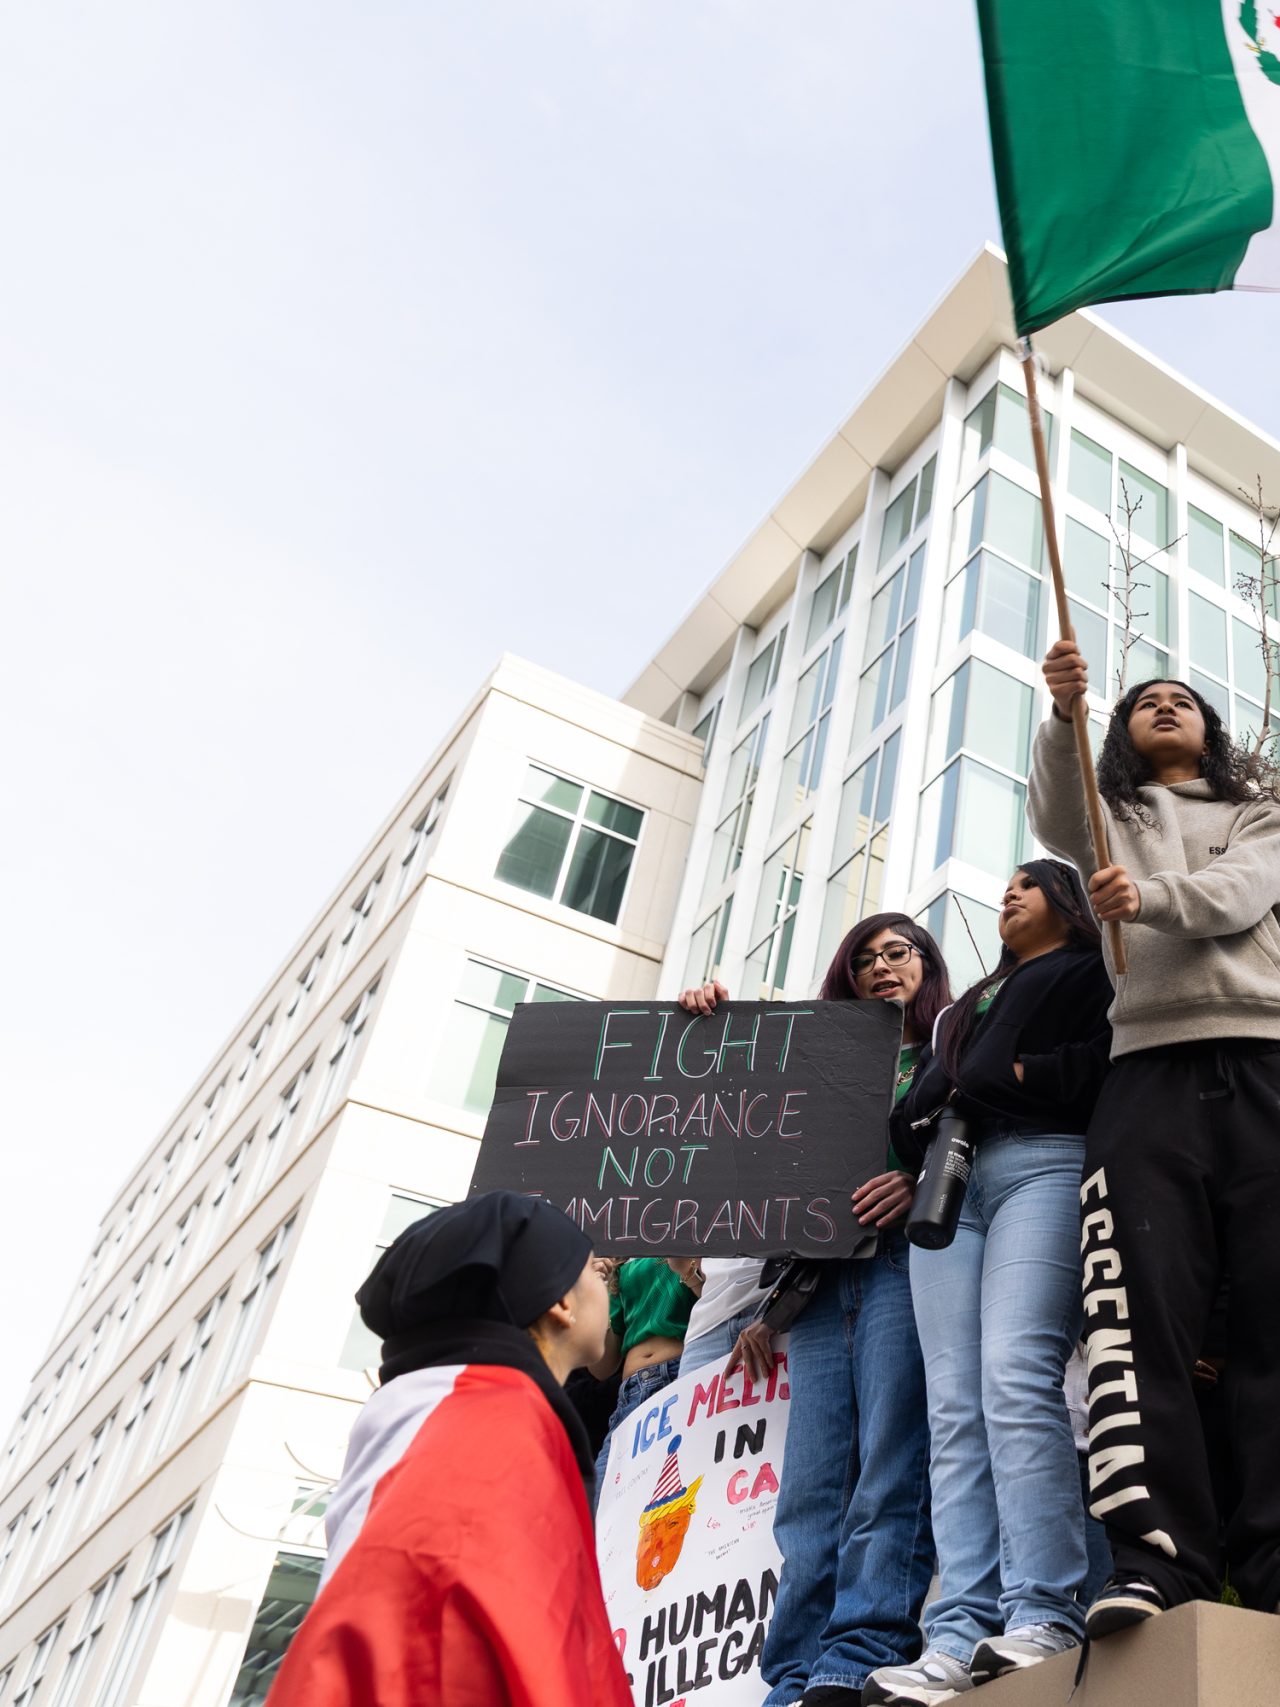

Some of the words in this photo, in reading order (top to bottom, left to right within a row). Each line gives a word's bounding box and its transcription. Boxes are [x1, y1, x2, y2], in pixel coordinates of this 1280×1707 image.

[593, 1009, 815, 1081] FIGHT
[513, 1090, 808, 1147] IGNORANCE
[597, 1144, 709, 1190] NOT
[522, 1190, 838, 1245] MIGRANTS
[1079, 1166, 1178, 1559] ESSENTIAL
[631, 1394, 680, 1460] ICE
[713, 1417, 767, 1464] IN
[726, 1462, 780, 1505] CA
[644, 1619, 773, 1707] ILLEGA
